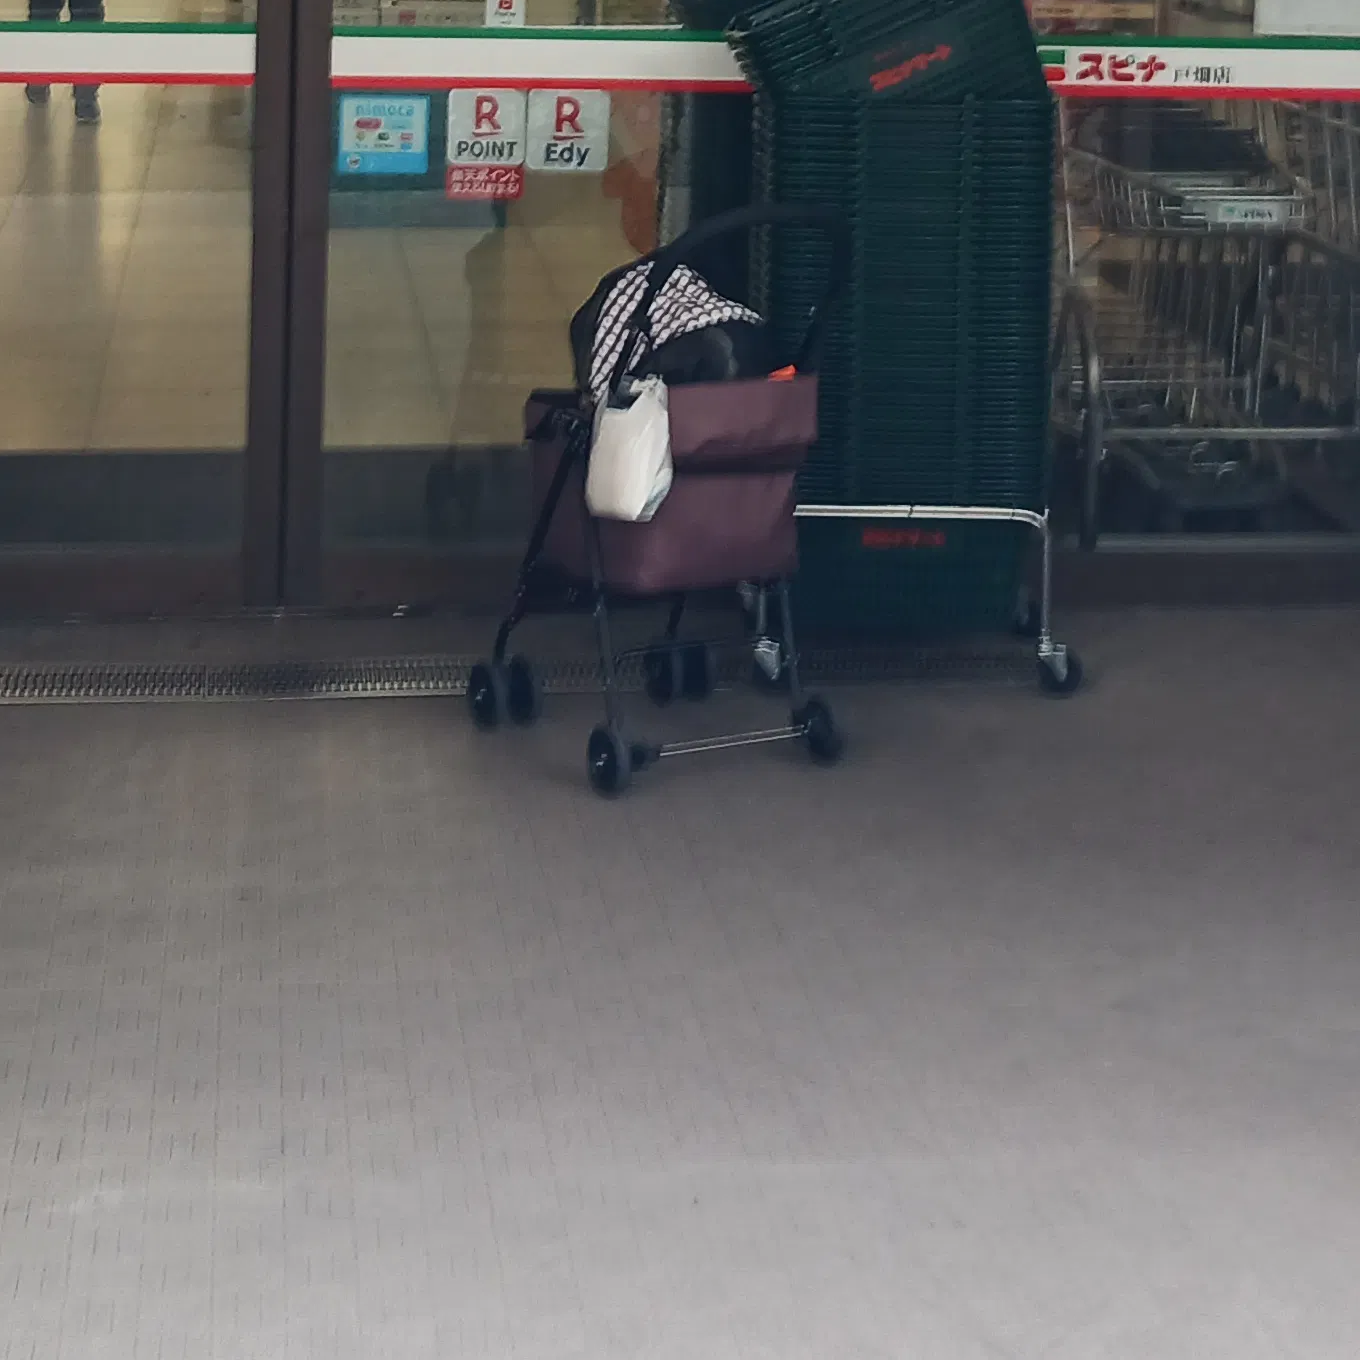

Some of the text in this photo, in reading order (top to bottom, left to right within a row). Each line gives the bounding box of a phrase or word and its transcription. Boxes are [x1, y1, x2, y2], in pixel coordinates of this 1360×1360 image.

[1076, 52, 1167, 83] スピナ
[355, 101, 415, 117] nimoca
[474, 95, 502, 130] R
[554, 95, 583, 133] R
[457, 141, 518, 158] POINT
[545, 142, 590, 167] Edy
